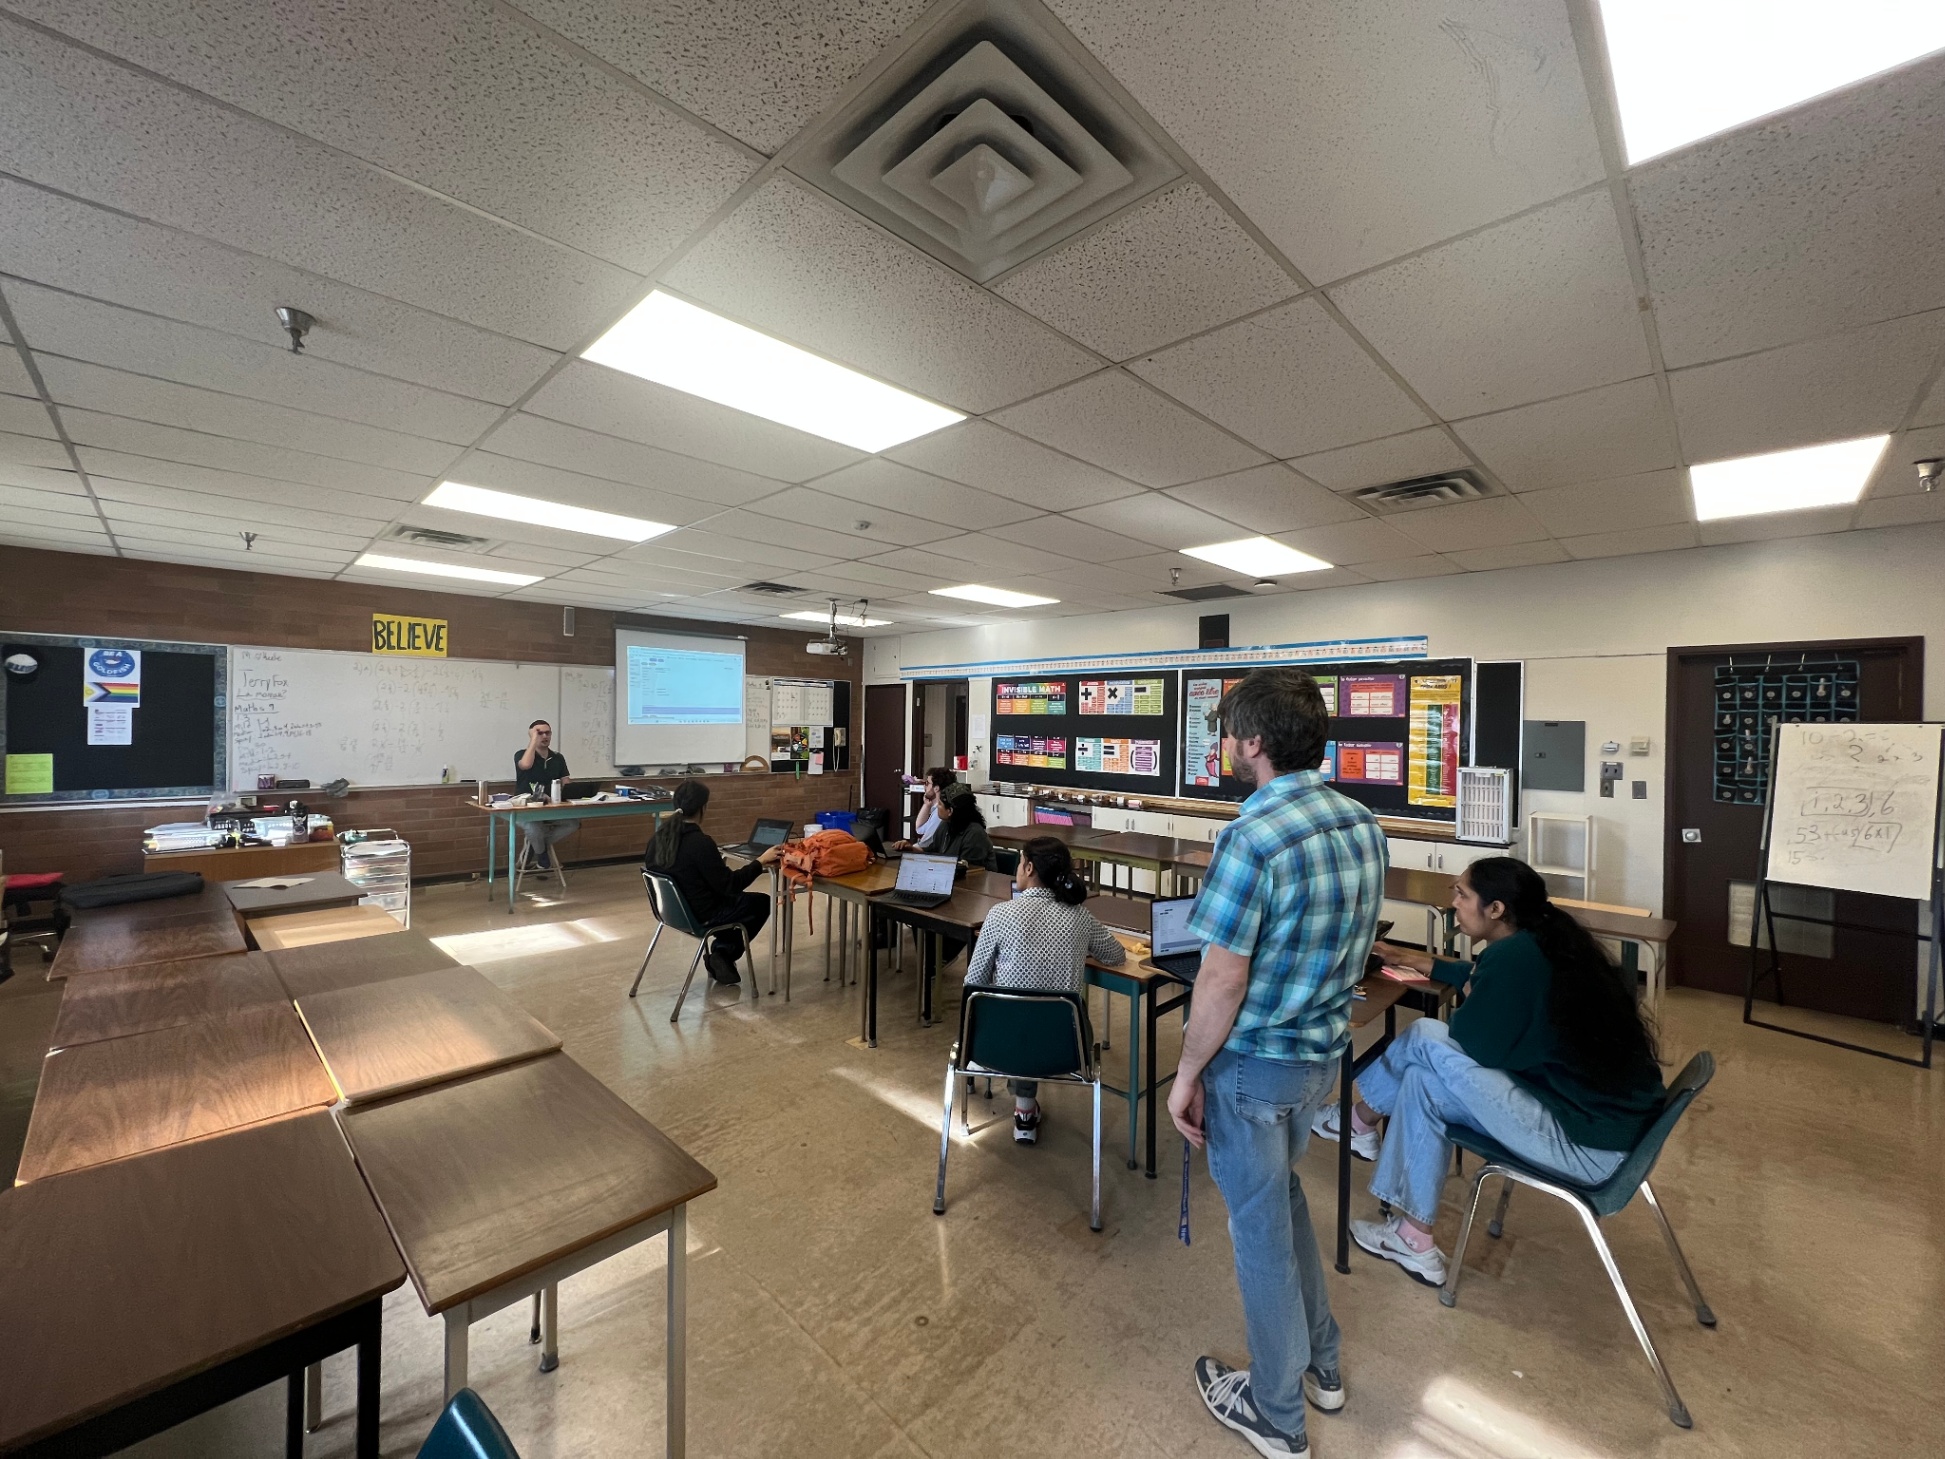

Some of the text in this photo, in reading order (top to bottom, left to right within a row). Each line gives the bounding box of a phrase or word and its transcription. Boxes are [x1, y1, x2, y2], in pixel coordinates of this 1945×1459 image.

[373, 619, 446, 652] BELIEVE
[93, 661, 132, 675] GOLDFISH
[272, 674, 288, 687] Fox
[1001, 685, 1061, 694] INVISIBLE MATH
[1881, 790, 1895, 815] 6
